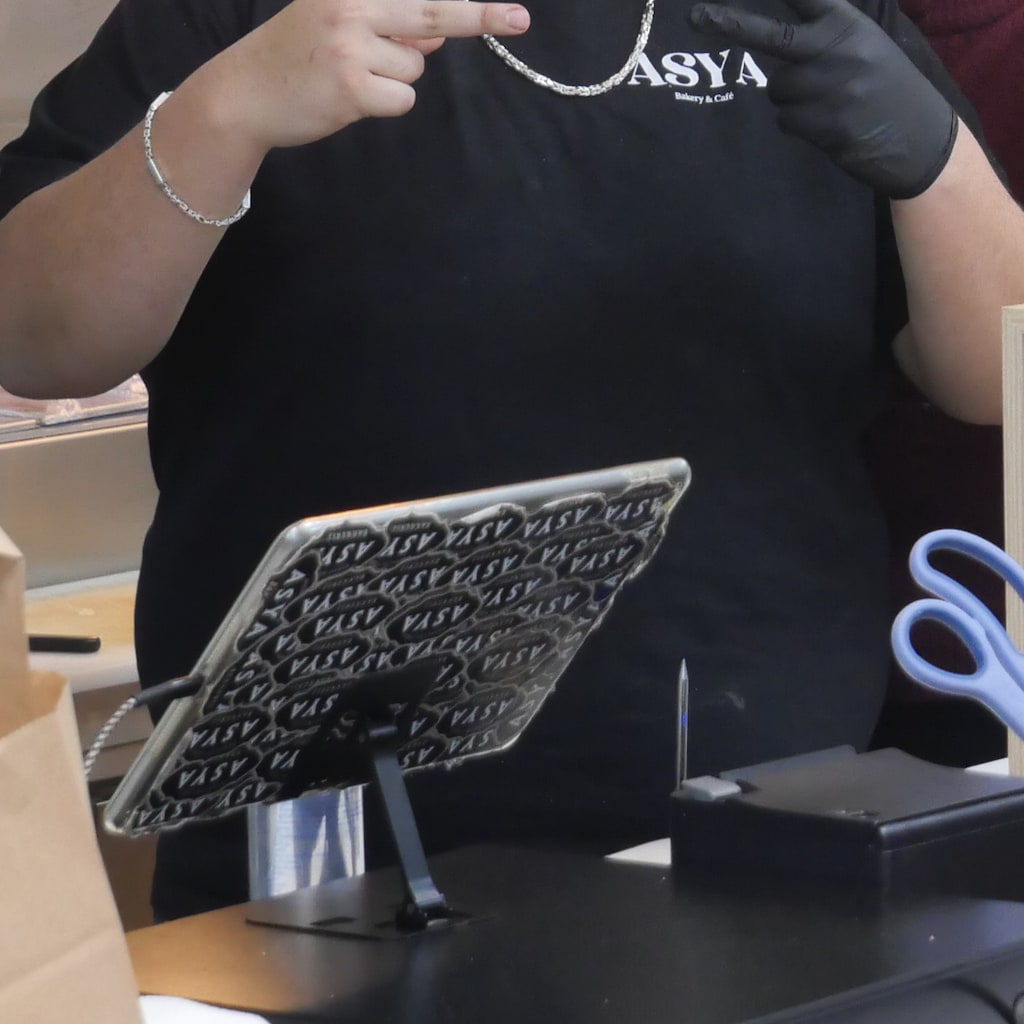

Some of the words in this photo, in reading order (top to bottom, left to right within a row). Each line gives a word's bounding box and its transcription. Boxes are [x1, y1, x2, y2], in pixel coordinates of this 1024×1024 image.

[627, 49, 768, 88] ASYA
[675, 91, 704, 105] Bakery
[705, 95, 713, 103] &
[714, 90, 735, 102] Café
[445, 518, 514, 548] ASYA
[523, 504, 593, 538] ASYA
[320, 540, 376, 566] ASY
[381, 532, 438, 556] ASY
[453, 554, 519, 585] ASYA
[569, 545, 635, 574] ASYA
[380, 566, 447, 596] ASYA
[247, 568, 307, 637] ASYA
[314, 605, 384, 636] ASYA
[402, 603, 469, 633] ASYA
[290, 645, 360, 676] ASYA
[482, 643, 547, 673] ASYA
[290, 693, 340, 720] SYA
[450, 698, 516, 727] ASYA
[189, 718, 260, 750] ASYA
[178, 757, 249, 790] ASYA
